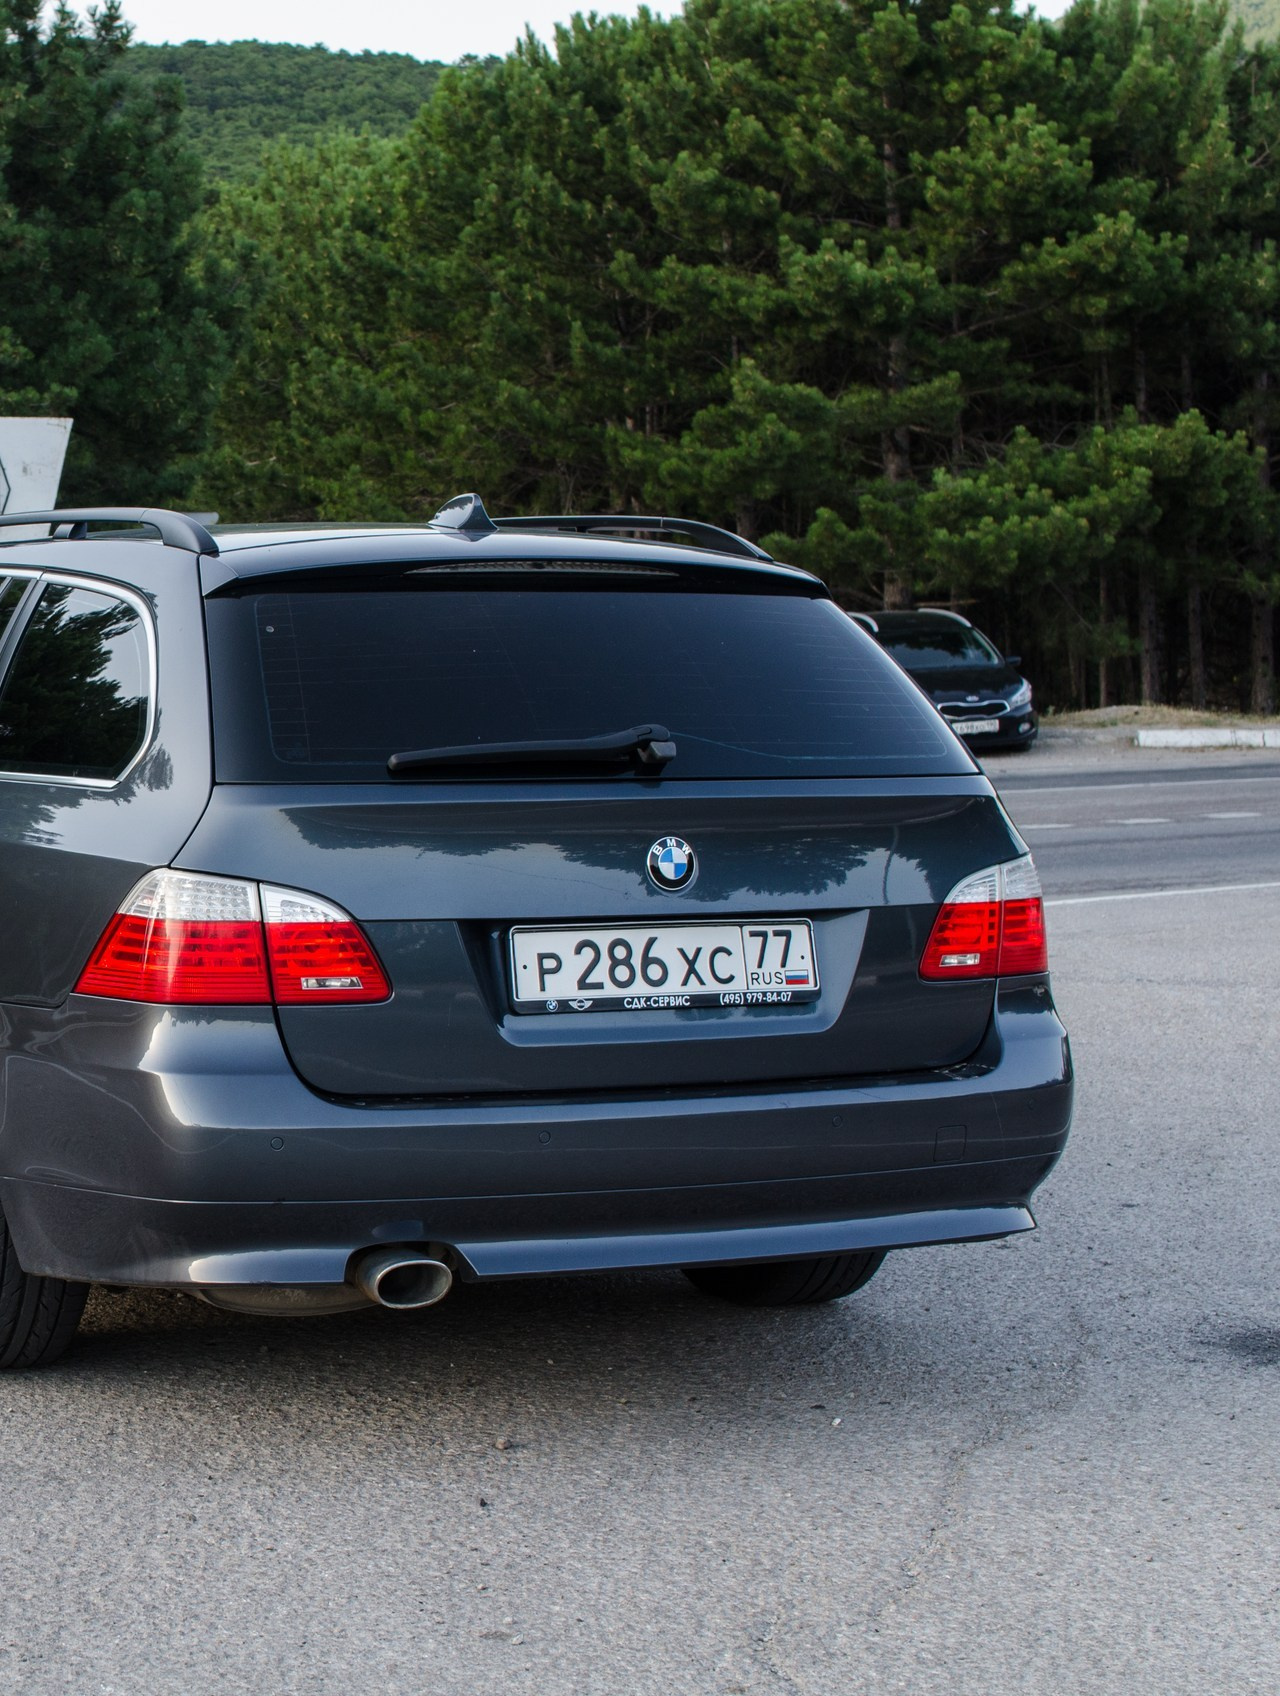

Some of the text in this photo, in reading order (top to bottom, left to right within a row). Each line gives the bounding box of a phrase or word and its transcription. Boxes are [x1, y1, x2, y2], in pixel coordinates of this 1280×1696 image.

[748, 929, 793, 969] 77
[750, 970, 784, 986] RUS
[719, 993, 744, 1006] (495)
[746, 991, 792, 1004] 979-84-07
